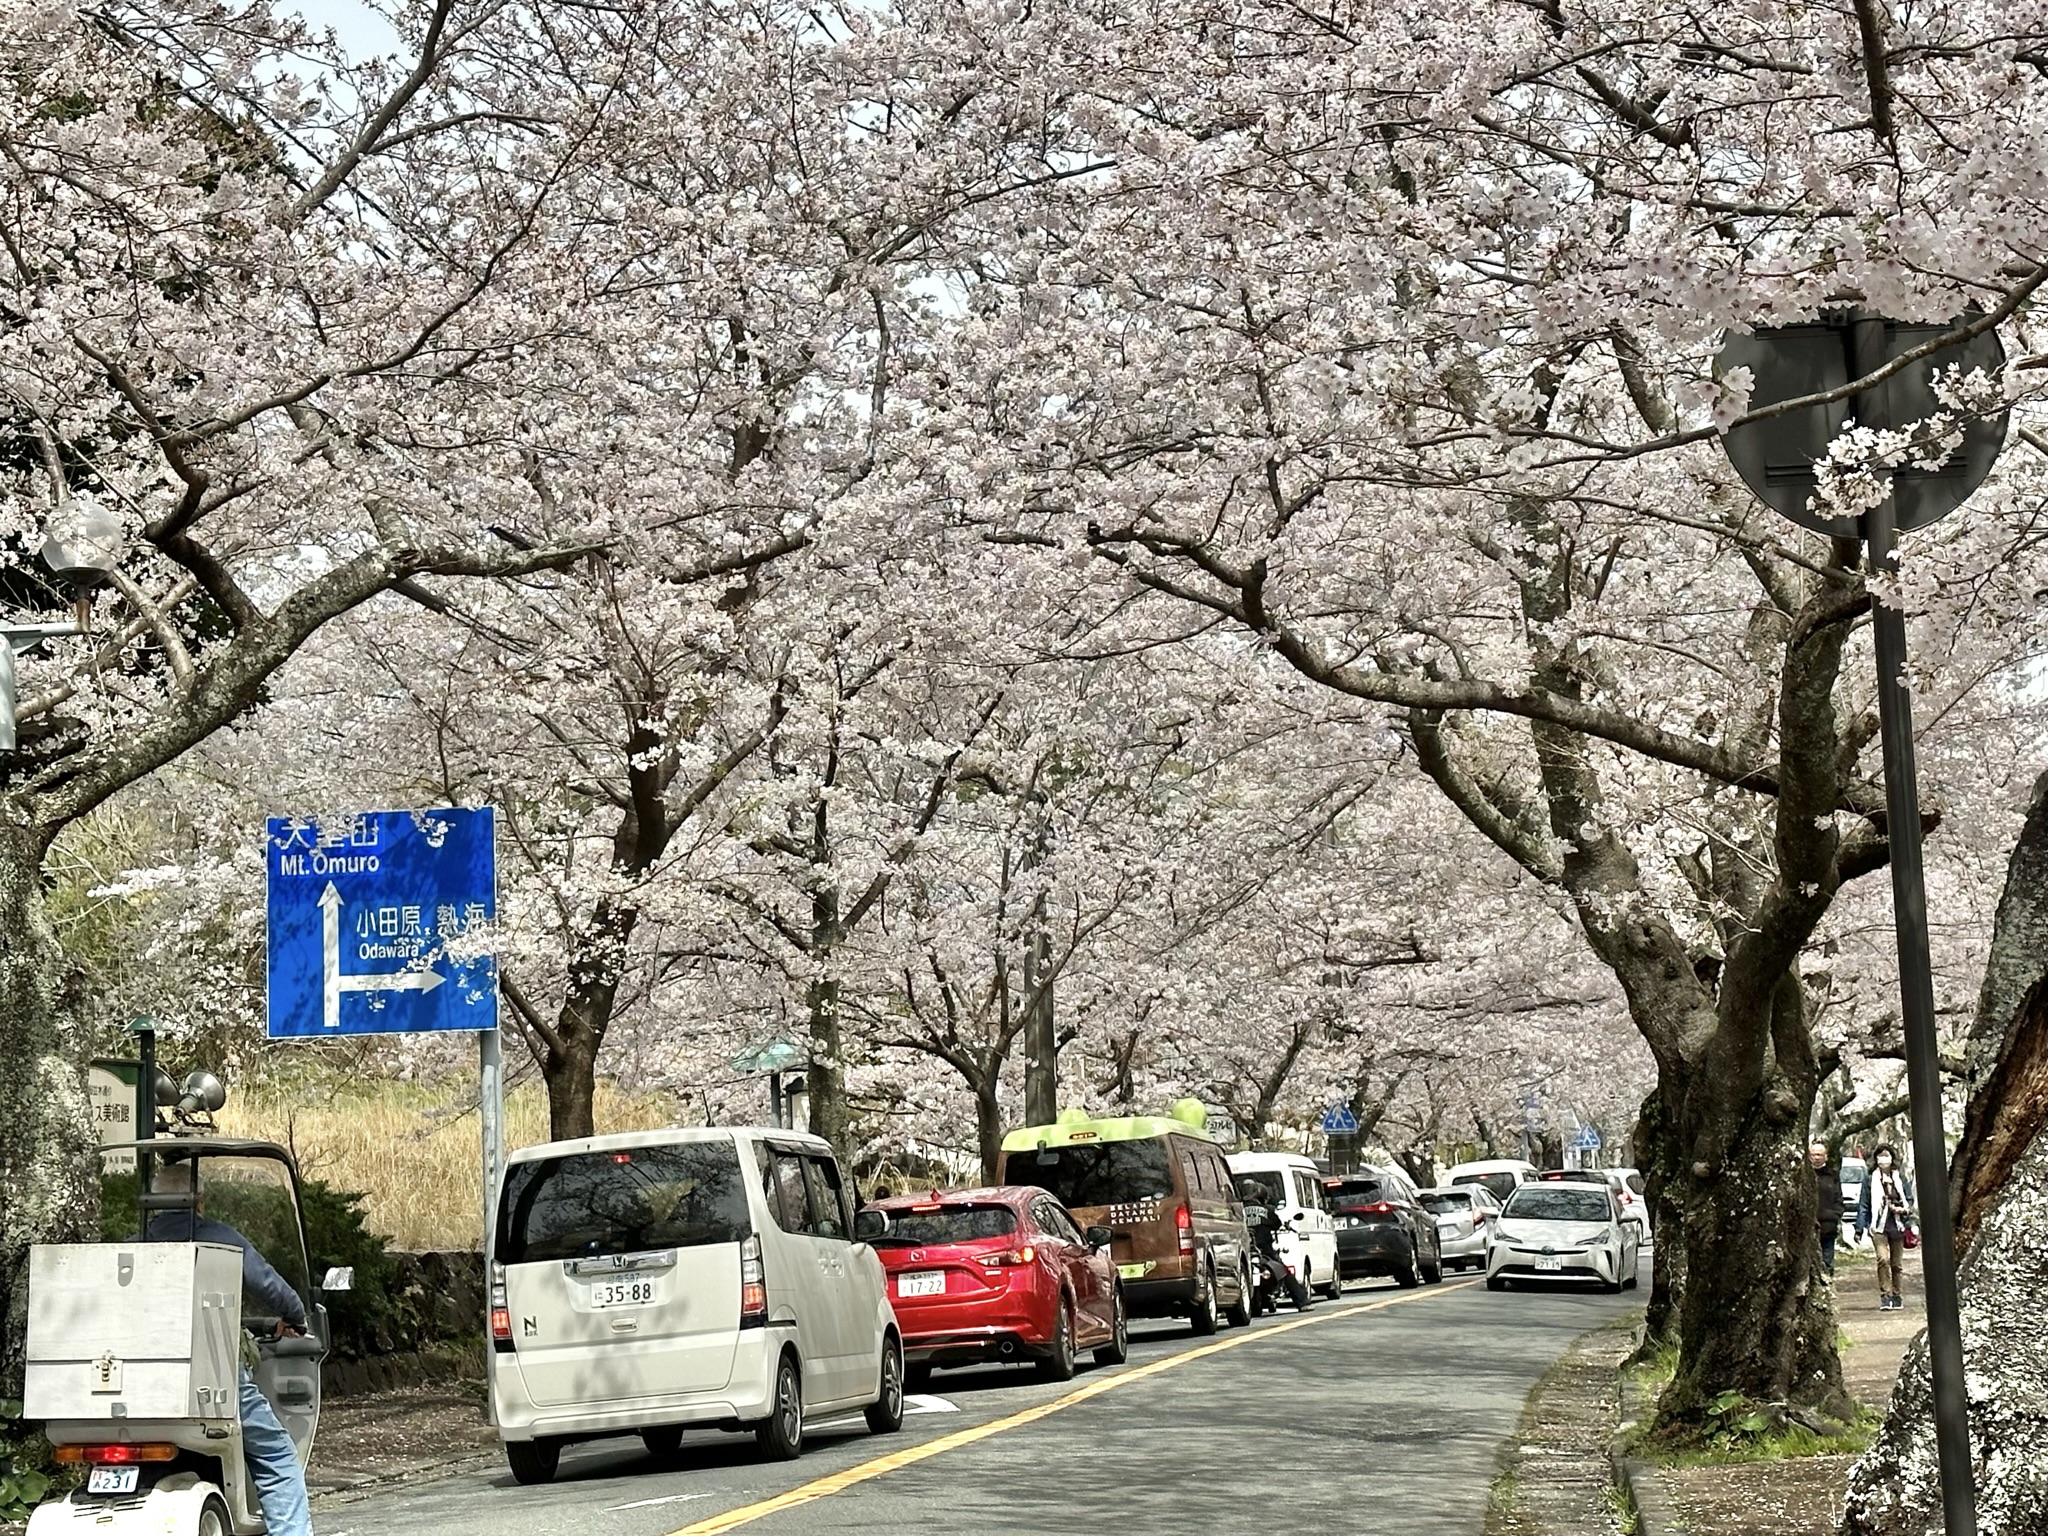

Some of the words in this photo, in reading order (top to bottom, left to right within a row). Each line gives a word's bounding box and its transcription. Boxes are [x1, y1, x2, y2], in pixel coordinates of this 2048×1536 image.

[281, 855, 310, 876] Mt.
[313, 852, 380, 875] Omuro
[357, 905, 421, 938] 小田原
[359, 942, 419, 960] Odawara
[1109, 1201, 1161, 1211] SELAMAT
[1110, 1208, 1154, 1218] DATANG
[1111, 1214, 1161, 1225] KEMBALI
[605, 1283, 651, 1303] 35-88
[910, 1280, 942, 1293] 17-22
[102, 1475, 131, 1489] 231
